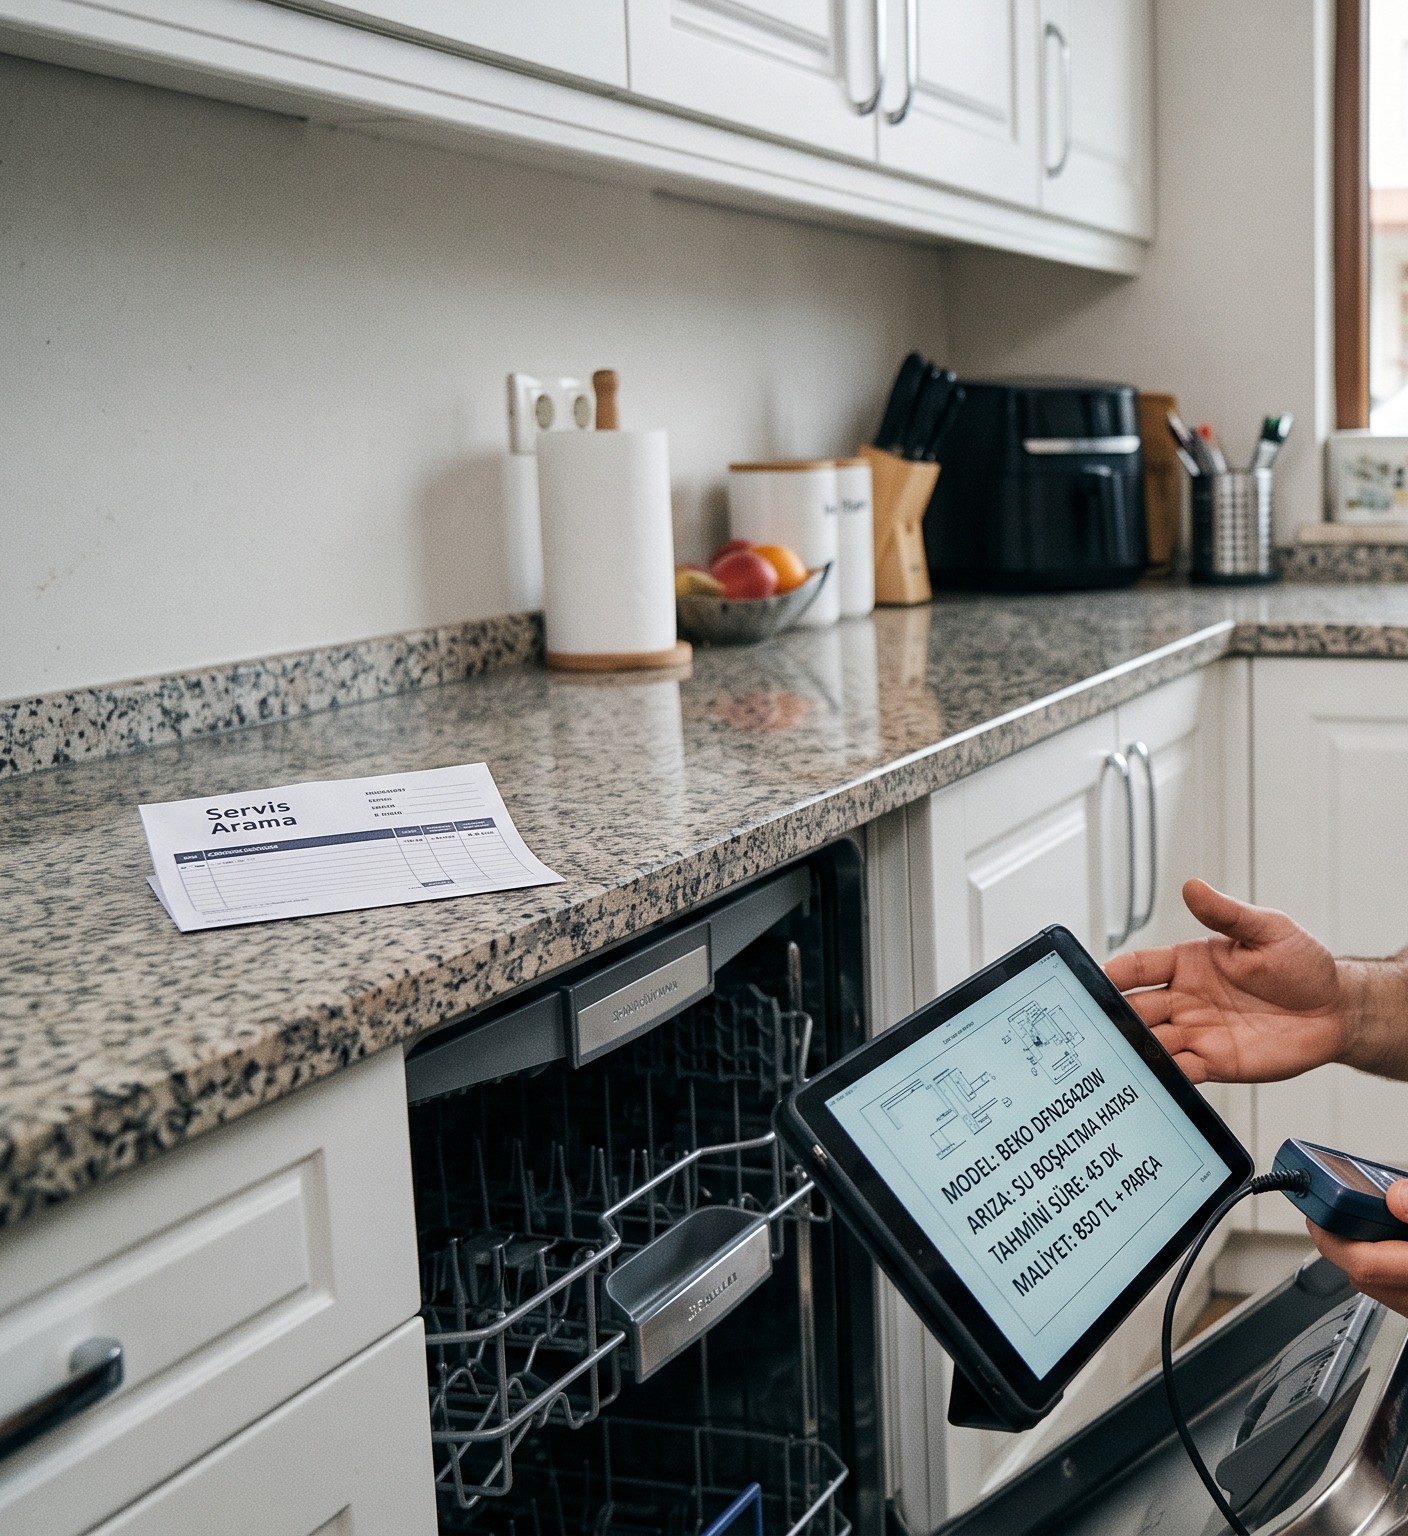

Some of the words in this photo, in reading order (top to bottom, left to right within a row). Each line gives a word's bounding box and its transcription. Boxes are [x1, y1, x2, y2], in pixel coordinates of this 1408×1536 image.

[206, 801, 290, 820] Servis
[211, 816, 297, 834] Arama
[941, 1155, 1000, 1204] MODEL:
[995, 1125, 1034, 1161] BEKO
[1030, 1068, 1105, 1134] DFN26420W
[966, 1191, 1017, 1235] ARIZA:
[1011, 1171, 1034, 1197] SU
[1030, 1118, 1102, 1180] BOŞALTMA
[1096, 1085, 1139, 1126] HATASI
[988, 1200, 1053, 1264] TAHMİNİ
[1048, 1176, 1089, 1214] SÜRE:
[1085, 1159, 1104, 1181] 45
[1100, 1143, 1123, 1168] DK
[1012, 1234, 1078, 1297] MALİYET:
[1072, 1210, 1101, 1240] 850
[1095, 1198, 1117, 1217] TL
[1115, 1190, 1123, 1201] +
[1121, 1155, 1163, 1196] PARÇA
